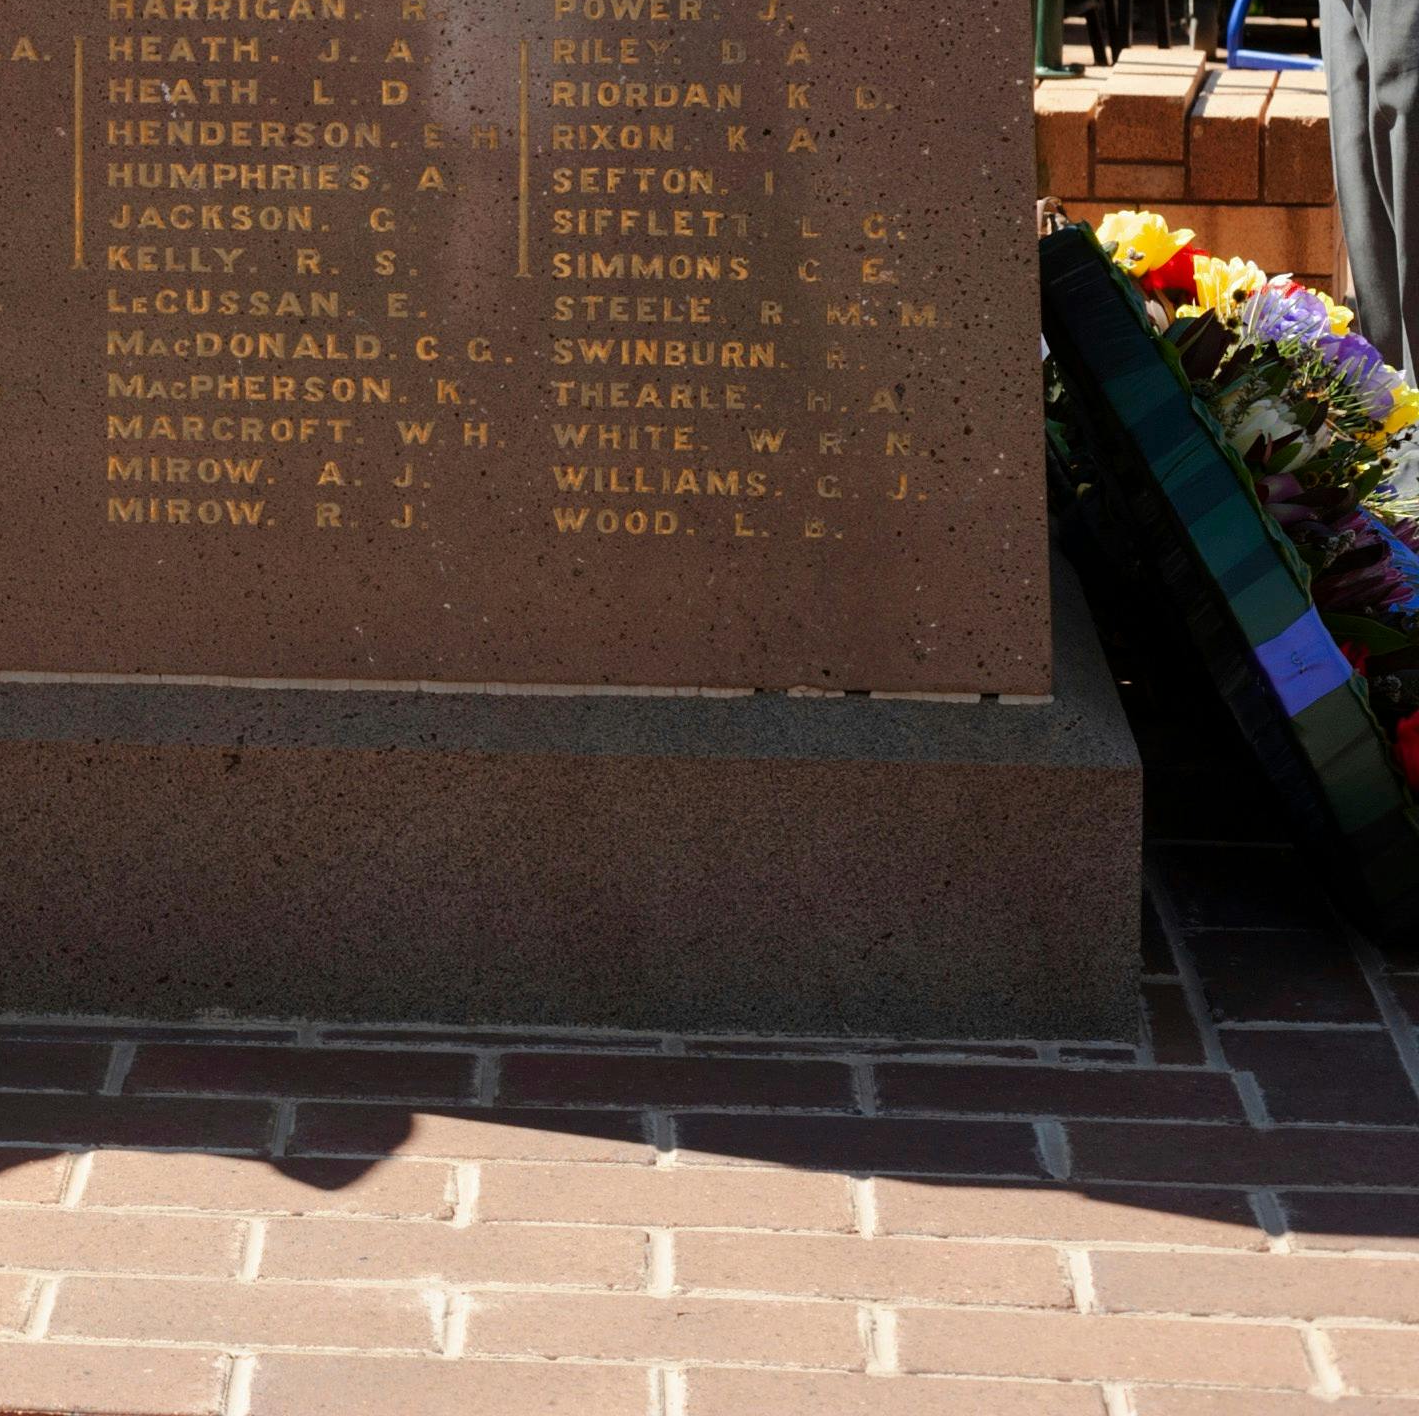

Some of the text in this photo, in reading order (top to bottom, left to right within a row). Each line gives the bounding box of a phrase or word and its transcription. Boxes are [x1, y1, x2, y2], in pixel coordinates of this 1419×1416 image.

[108, 36, 280, 63] HEATH.
[107, 120, 397, 148] HENDERSON.
[552, 168, 729, 195] SEFTON.
[111, 205, 329, 232] JACKSON.
[107, 246, 257, 273] KELLY.
[387, 292, 427, 318] E.
[552, 339, 789, 368] SWINBURN.
[107, 415, 364, 444] MARCROFT.
[107, 456, 275, 484] MIROW.
[552, 466, 782, 496] WILLIAMS.
[107, 497, 276, 526] MIROW.
[552, 507, 695, 535] WOOD.
